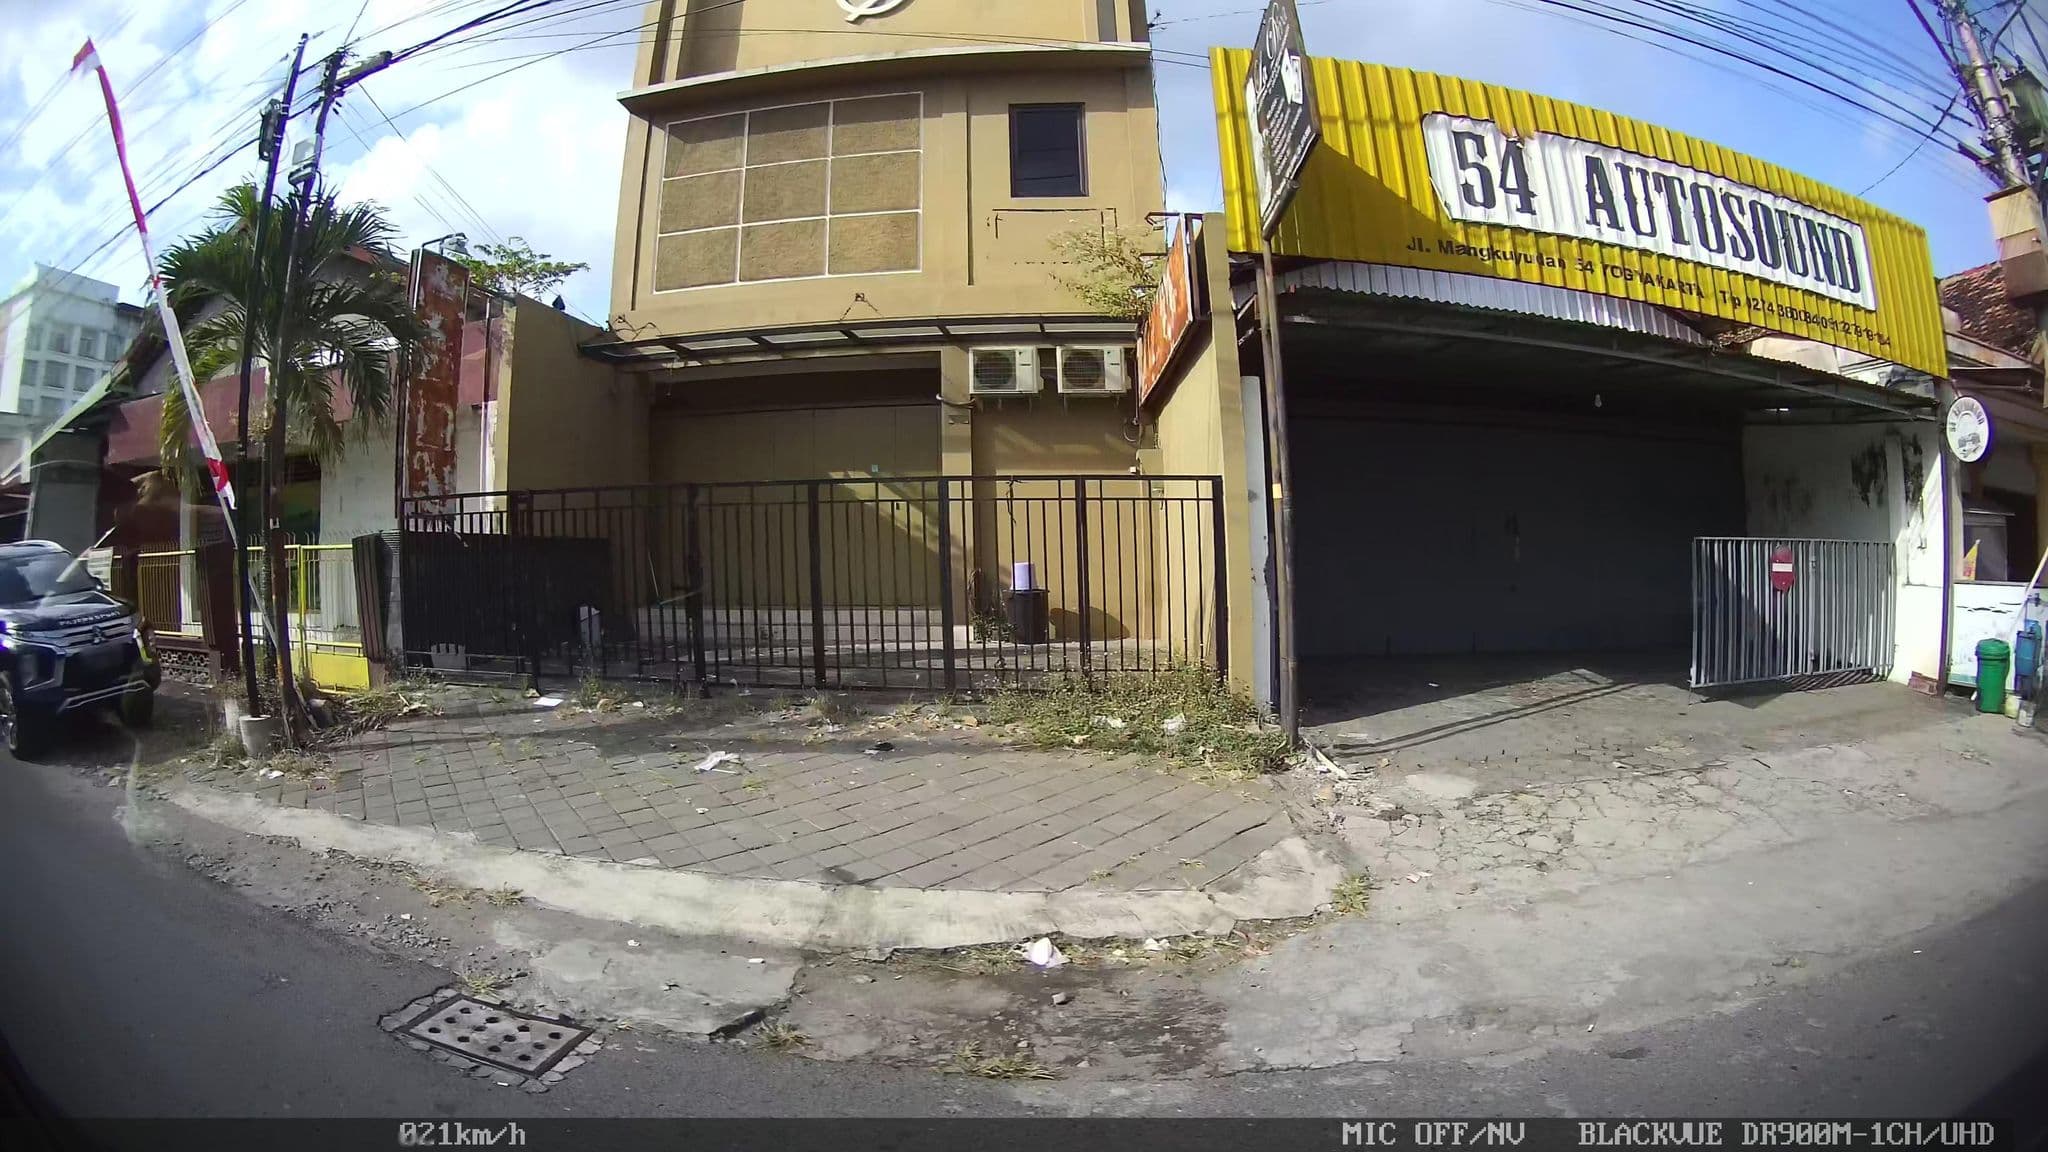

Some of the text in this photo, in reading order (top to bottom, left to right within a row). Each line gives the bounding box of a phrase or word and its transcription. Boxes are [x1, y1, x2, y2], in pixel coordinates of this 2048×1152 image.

[1406, 236, 1431, 253] Jl.
[1437, 239, 1566, 270] Mangkuyudan
[1575, 257, 1595, 275] 54
[1602, 263, 1705, 299] YOGYAKARTA
[1451, 130, 1862, 294] 54 AUTOSOUND
